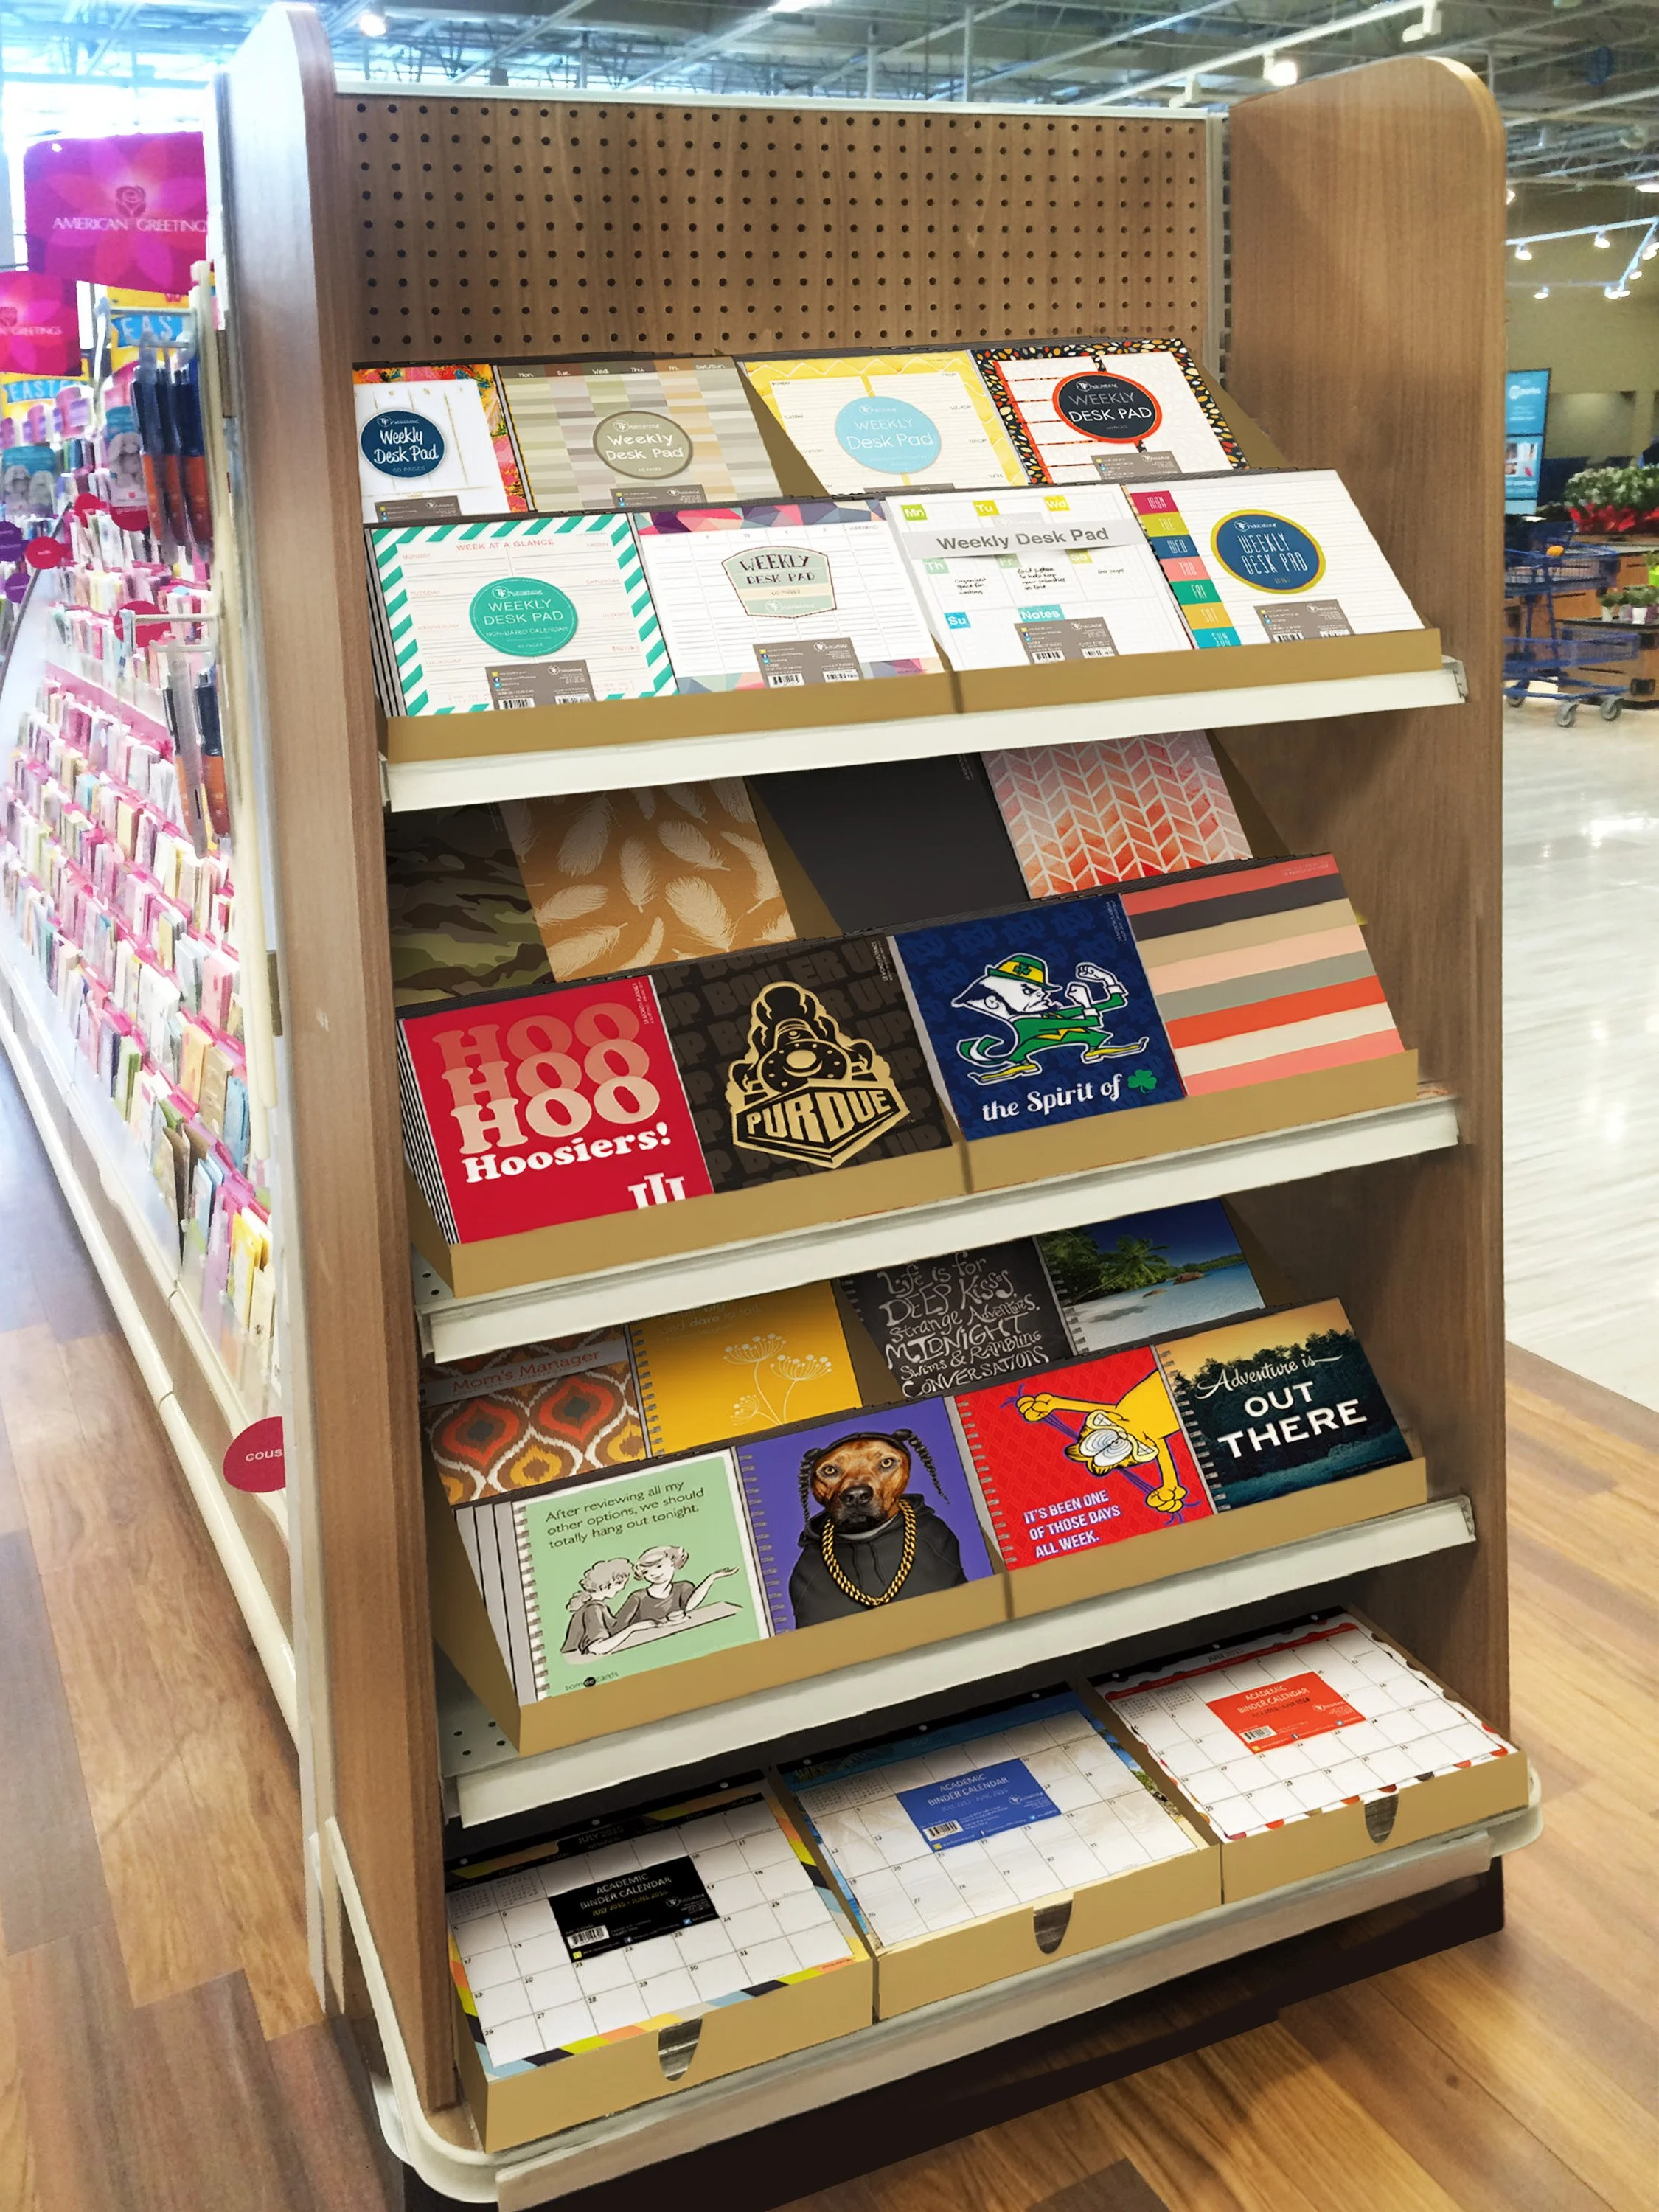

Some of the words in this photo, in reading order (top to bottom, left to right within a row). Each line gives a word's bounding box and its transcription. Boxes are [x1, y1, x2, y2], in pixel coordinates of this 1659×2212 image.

[52, 218, 129, 231] AMERICAN
[1068, 392, 1135, 406] WEEKLY
[853, 418, 913, 431] WEEKLY
[1069, 408, 1116, 423] DESK
[1119, 407, 1152, 420] PAD
[380, 426, 424, 445] Weekly
[606, 433, 673, 447] Weekly
[846, 434, 894, 451] Desk
[897, 432, 933, 447] Pad
[374, 449, 410, 465] Desk
[409, 444, 439, 462] Pad
[605, 449, 647, 462] Desk
[654, 447, 684, 459] Pad
[904, 507, 925, 518] Mn
[975, 504, 993, 514] Tu
[1046, 499, 1067, 509] Wd
[1147, 497, 1167, 509] MON
[1160, 518, 1177, 532] TUE
[456, 543, 485, 552] WEEK
[513, 538, 554, 547] GLANCE
[937, 534, 1009, 552] Weekly
[1015, 529, 1066, 546] Desk
[1070, 527, 1110, 542] Pad
[1167, 539, 1188, 554] WED
[1237, 532, 1290, 554] WEEKLY
[739, 554, 810, 572] WEEKLY
[925, 560, 945, 571] Th
[999, 556, 1013, 566] Fr
[1179, 562, 1197, 576] THU
[1241, 554, 1279, 575] DESK
[1279, 552, 1309, 572] PAD
[746, 574, 781, 585] DESK
[788, 572, 815, 582] PAD
[1191, 584, 1207, 599] FRI
[488, 599, 552, 612] WEEKLY
[1020, 607, 1060, 621] Notes
[1200, 608, 1218, 622] SAT
[483, 614, 527, 625] DESK
[532, 610, 563, 622] PAD
[948, 616, 967, 626] Su
[1213, 632, 1231, 647] SUN
[432, 1002, 640, 1070] HOO
[442, 1038, 650, 1108] HOO
[982, 1100, 1020, 1122] the
[1027, 1084, 1093, 1116] Spirit
[1100, 1074, 1123, 1102] of
[450, 1075, 661, 1155] HOO
[746, 1090, 891, 1144] PURDUE
[460, 1121, 672, 1183] Hoosiers!
[877, 1264, 923, 1298] Life
[932, 1267, 951, 1283] is
[952, 1252, 987, 1277] for
[878, 1282, 952, 1327] DEEP
[689, 1315, 720, 1327] dare
[452, 1370, 514, 1393] Mom's
[520, 1350, 600, 1377] Manager
[900, 1359, 947, 1381] Swims
[950, 1350, 967, 1368] &
[1194, 1360, 1298, 1399] Adventure
[1244, 1380, 1315, 1418] OUT
[1217, 1398, 1368, 1459] THERE
[546, 1507, 581, 1523] After
[584, 1488, 646, 1513] reviewing
[647, 1484, 662, 1498] all
[665, 1481, 685, 1496] my
[1023, 1506, 1048, 1525] IT'S
[1049, 1497, 1082, 1518] BEEN
[1083, 1489, 1110, 1508] ONE
[547, 1520, 584, 1536] other
[587, 1506, 638, 1528] options,
[639, 1503, 661, 1514] we
[663, 1488, 705, 1507] should
[549, 1532, 589, 1550] totally
[592, 1524, 624, 1539] hang
[627, 1517, 649, 1529] out
[653, 1504, 700, 1524] tonight.
[1029, 1523, 1046, 1541] OF
[1048, 1512, 1088, 1536] THOSE
[1089, 1505, 1121, 1525] DAYS
[1034, 1540, 1059, 1559] ALL
[1059, 1530, 1100, 1552] WEEK.
[1237, 1700, 1268, 1714] BINDER
[1267, 1687, 1310, 1704] CALENDAR
[1245, 1684, 1287, 1702] ACADEMIC
[927, 1791, 962, 1806] BINDER
[962, 1776, 1009, 1796] CALENDAR
[939, 1773, 987, 1792] ACADEMIC
[577, 1833, 600, 1844] JULY
[601, 1826, 625, 1837] 2015
[580, 1888, 618, 1910] BINDER
[619, 1876, 672, 1899] CALENDAR
[596, 1873, 650, 1895] ACADEMIC
[592, 1905, 608, 1917] JULY
[632, 1895, 650, 1905] JUNE
